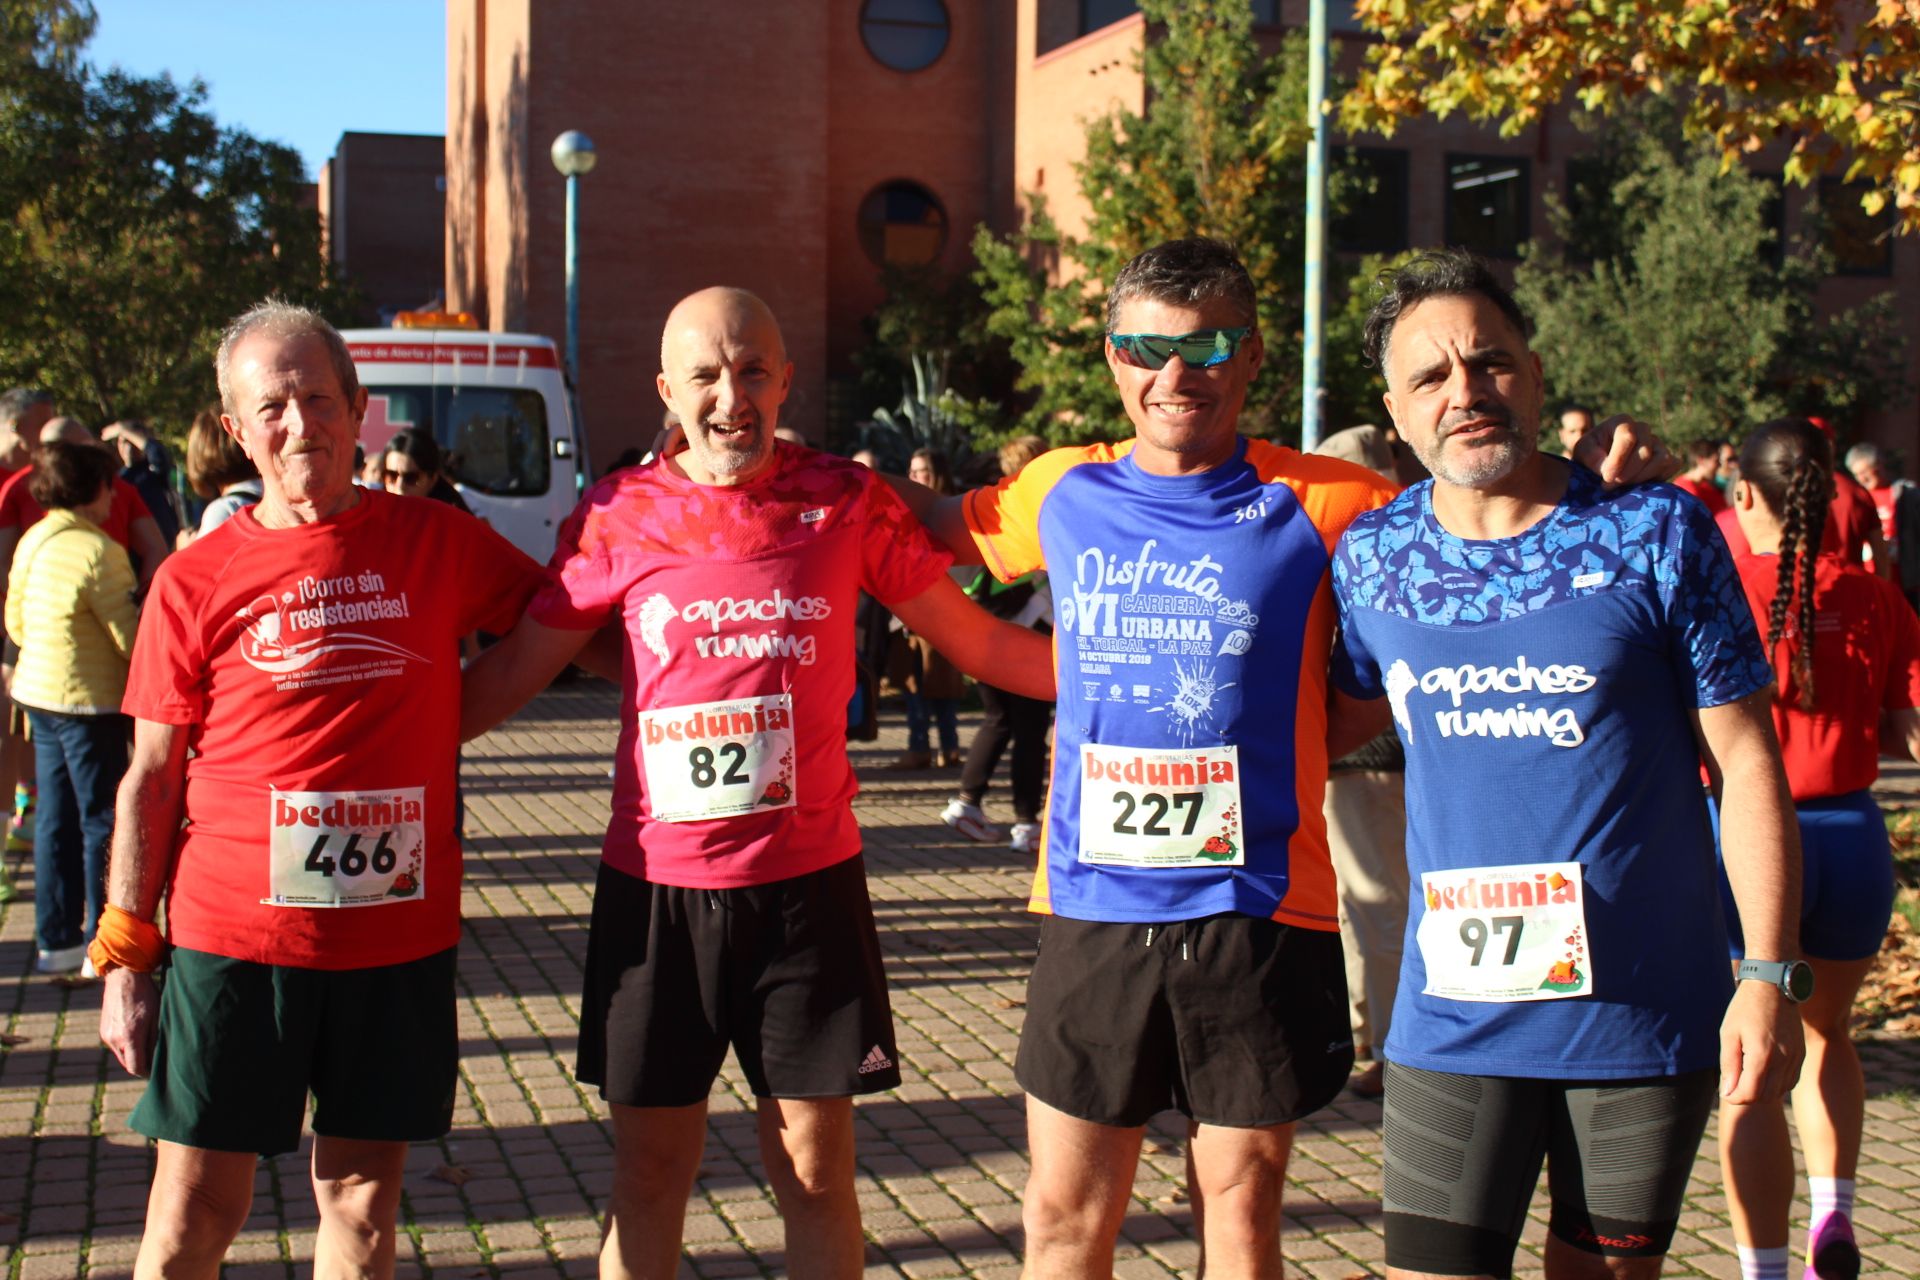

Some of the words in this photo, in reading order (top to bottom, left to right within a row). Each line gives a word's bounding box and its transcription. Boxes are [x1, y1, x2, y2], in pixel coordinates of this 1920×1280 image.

[349, 346, 372, 358] unto
[390, 346, 424, 359] Alerta
[298, 575, 355, 604] ¡Corre
[358, 569, 385, 593] sin
[1073, 539, 1223, 602] Disfruta
[289, 592, 410, 632] resistencias!
[682, 589, 832, 633] apaches
[1077, 593, 1120, 636] VI
[1121, 594, 1214, 616] CARRERA
[1217, 597, 1259, 626] 2020
[695, 630, 816, 666] running
[1076, 636, 1091, 650] EL
[1091, 637, 1147, 653] TORCAL
[1158, 640, 1178, 655] LA
[1181, 641, 1212, 656] PAZ
[1121, 616, 1213, 641] URBANA
[1087, 651, 1128, 664] OCTUBRE
[1420, 655, 1596, 707] apaches
[645, 705, 789, 746] bedunia
[1436, 703, 1584, 747] running
[689, 742, 749, 789] 82
[1086, 752, 1234, 786] bedunia
[275, 796, 421, 828] bedunia
[1113, 791, 1204, 836] 227
[305, 831, 396, 877] 466
[1426, 873, 1576, 912] bedunia
[1459, 915, 1524, 966] 97
[858, 1059, 892, 1074] adidas
